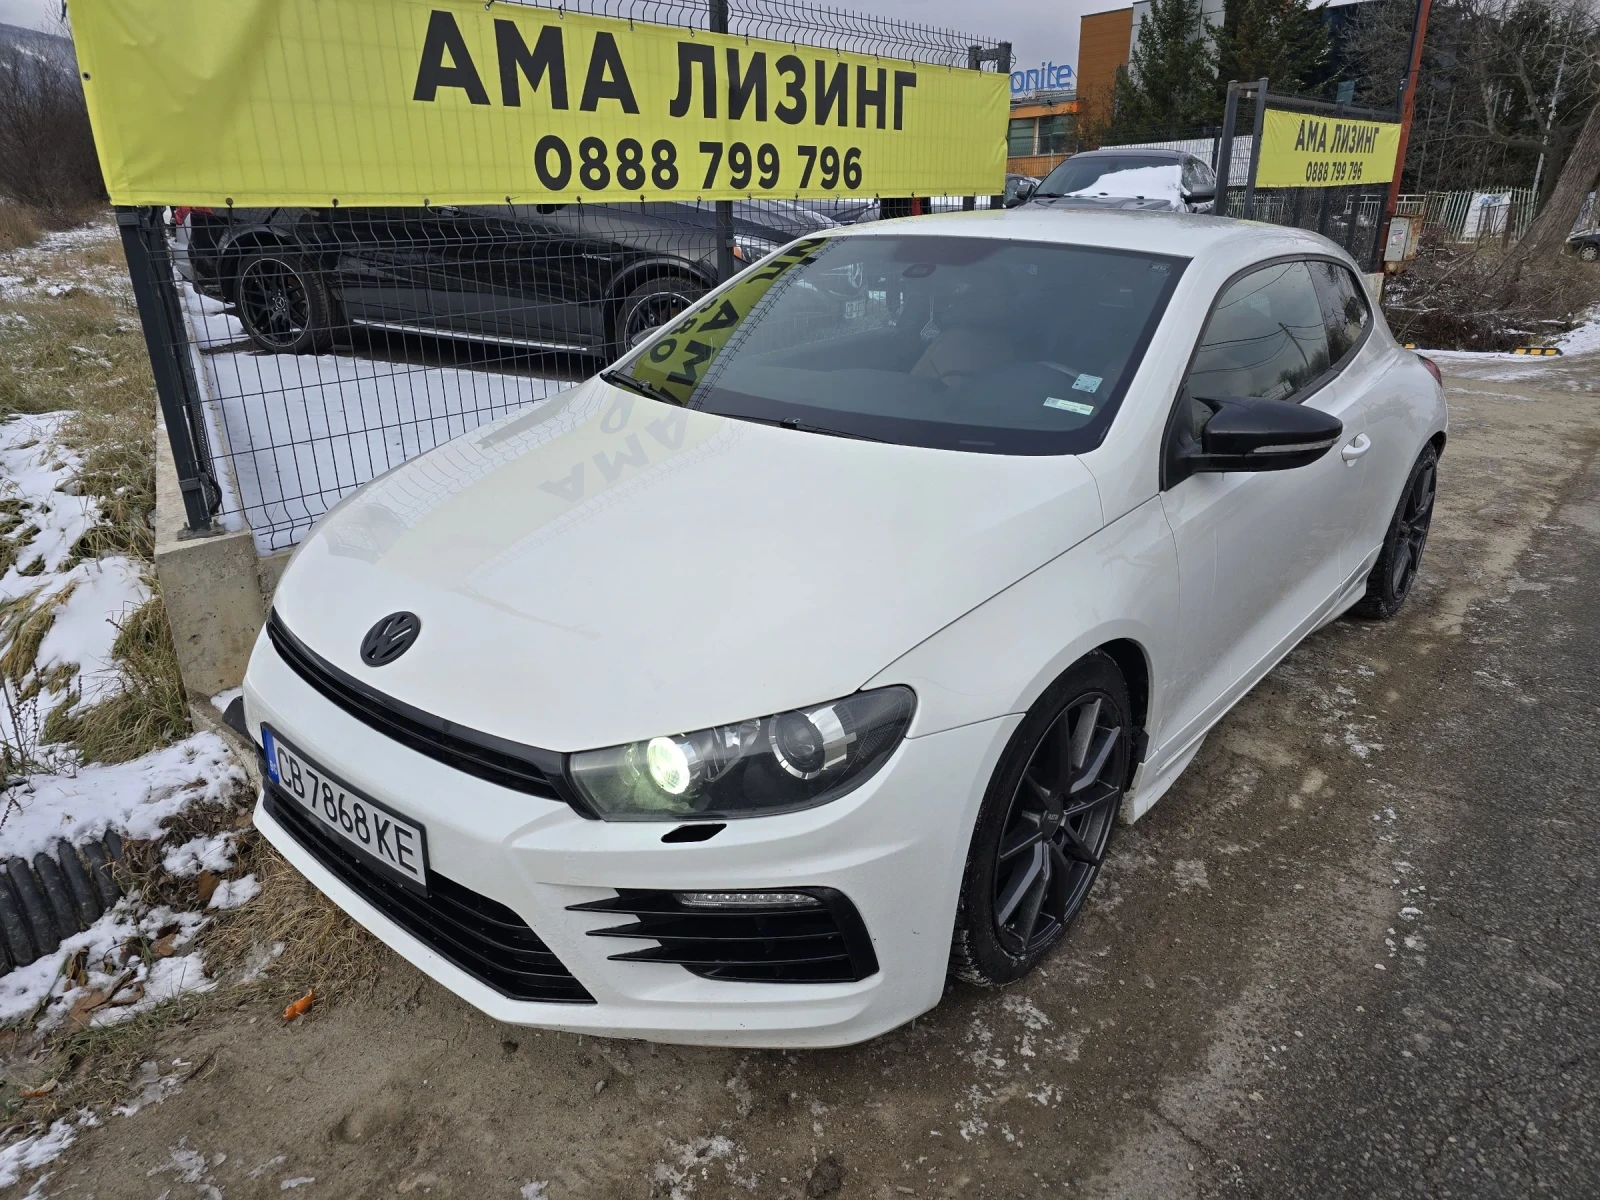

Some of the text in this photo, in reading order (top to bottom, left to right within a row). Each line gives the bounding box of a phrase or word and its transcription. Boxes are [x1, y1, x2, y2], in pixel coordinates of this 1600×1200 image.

[413, 10, 916, 132] АМА ЛИЗИНГ
[1295, 119, 1379, 154] АМА ЛИЗИНГ
[535, 134, 862, 191] 0888 799 796
[1306, 161, 1363, 182] 0888 799 796
